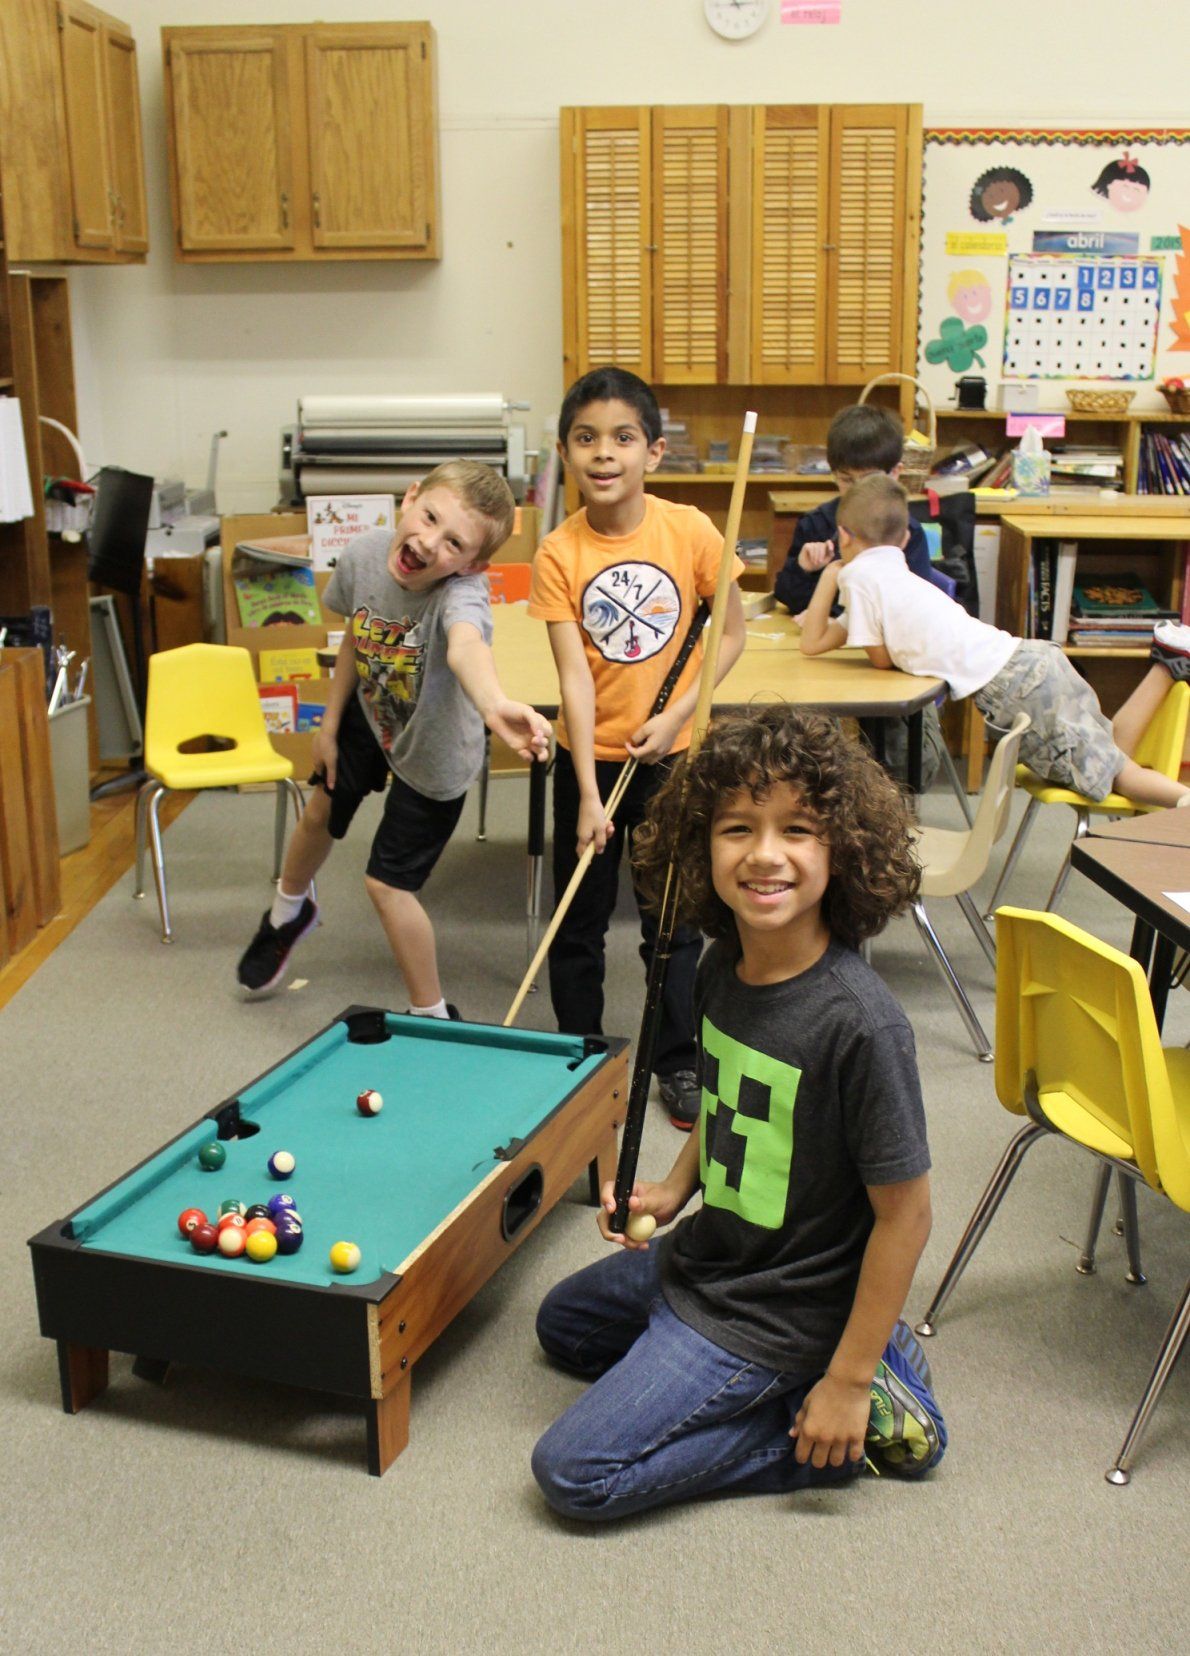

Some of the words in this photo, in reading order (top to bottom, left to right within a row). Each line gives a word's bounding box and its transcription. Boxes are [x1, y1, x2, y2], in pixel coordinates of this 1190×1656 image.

[1067, 233, 1105, 249] abril
[1101, 270, 1111, 285] 2
[1123, 270, 1133, 285] 3
[1145, 271, 1157, 286] 4
[1015, 290, 1025, 304] 5
[1036, 291, 1047, 305] 6
[1057, 291, 1067, 305] 7
[1081, 291, 1091, 306] 8
